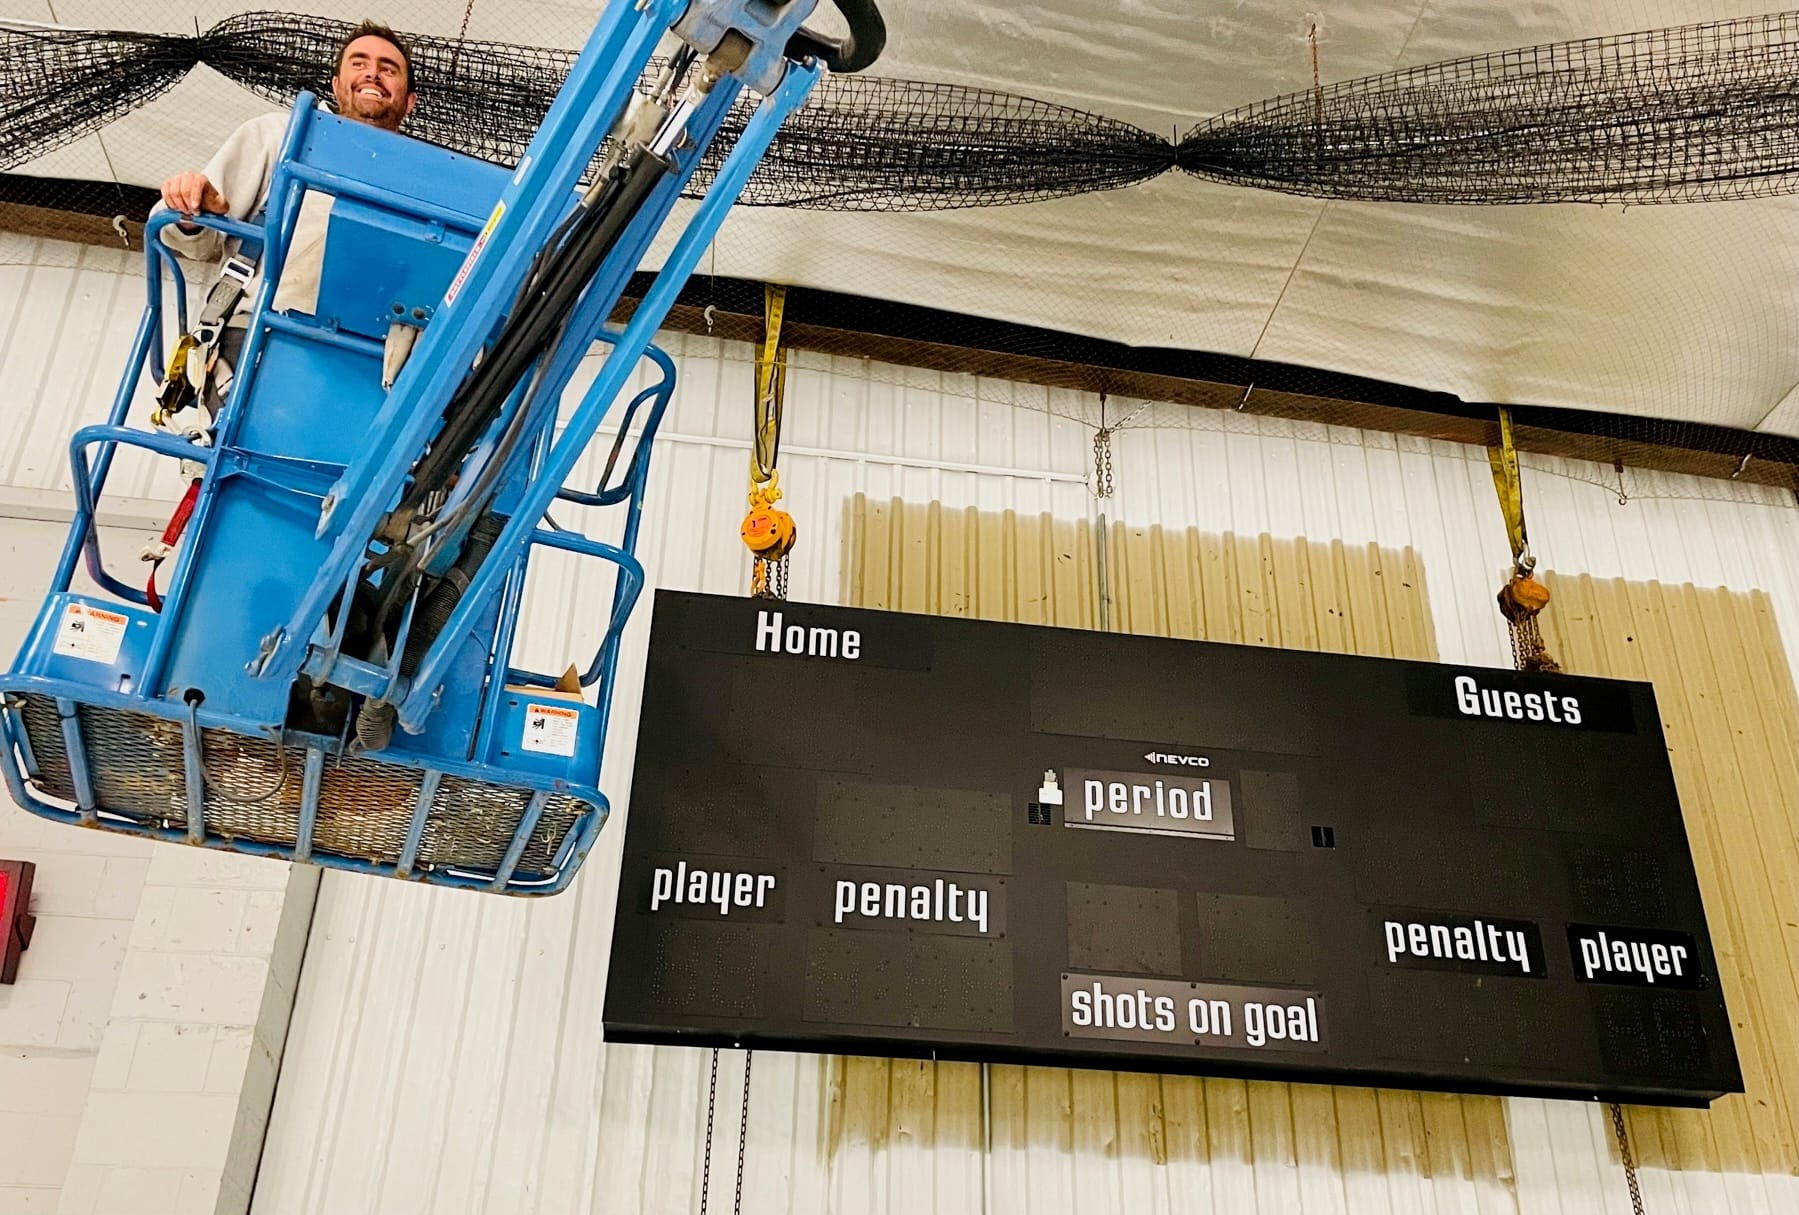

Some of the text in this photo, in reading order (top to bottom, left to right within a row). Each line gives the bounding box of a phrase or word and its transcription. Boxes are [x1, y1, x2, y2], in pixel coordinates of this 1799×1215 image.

[755, 610, 861, 659] Home
[1454, 675, 1582, 724] Guests
[1084, 780, 1213, 821] period
[651, 861, 775, 915] player
[834, 879, 988, 933] penalty
[1384, 920, 1530, 973] penalty
[1580, 931, 1687, 983] player
[1072, 982, 1318, 1047] shots on goal
